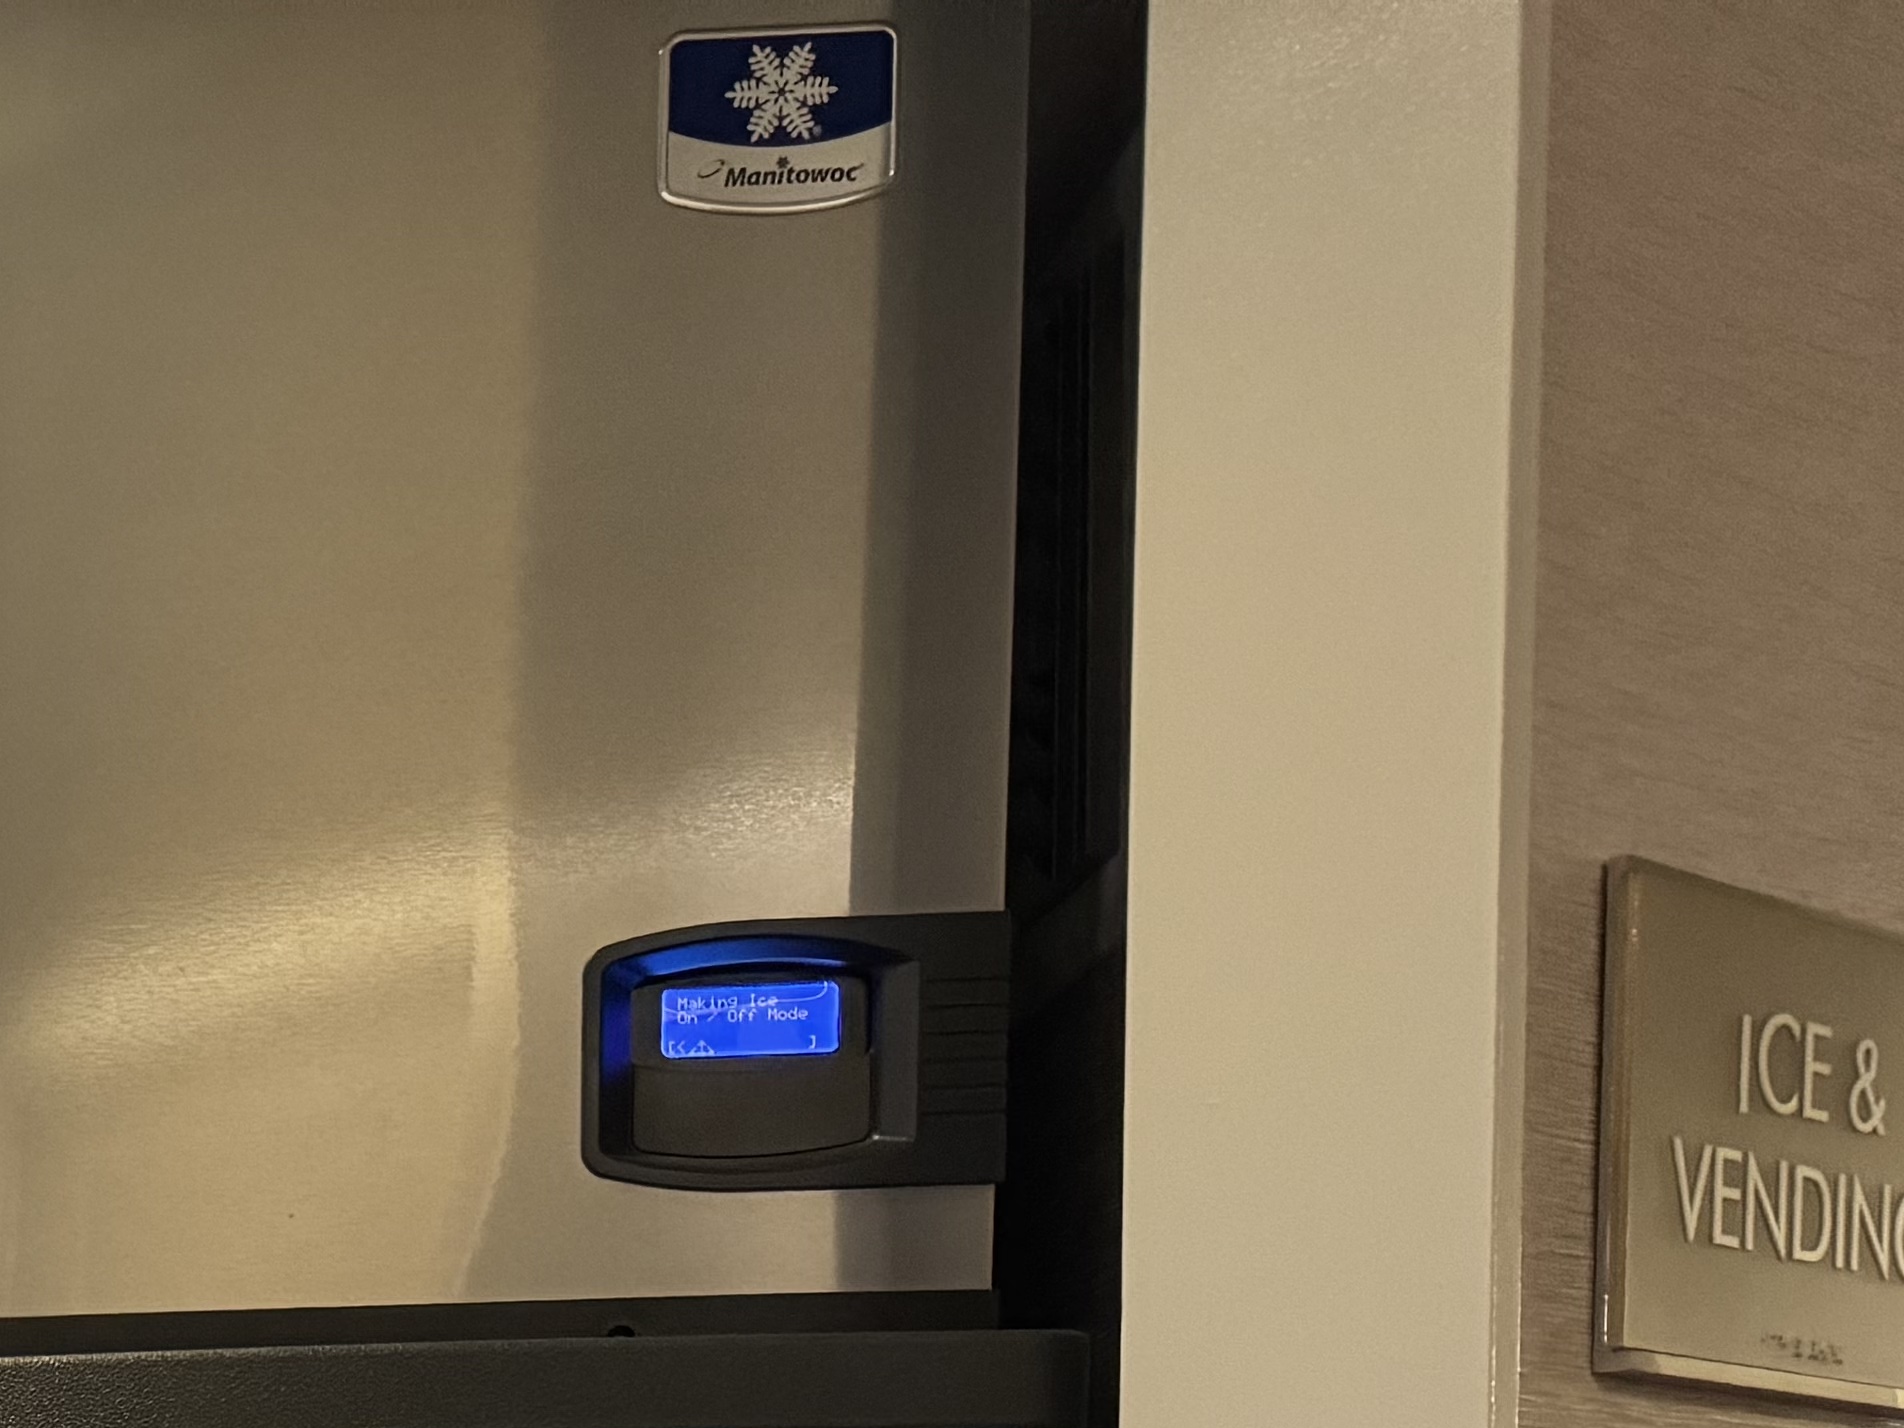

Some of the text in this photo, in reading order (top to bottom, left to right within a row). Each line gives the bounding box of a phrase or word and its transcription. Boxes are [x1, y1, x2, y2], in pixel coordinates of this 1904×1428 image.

[724, 159, 863, 188] Manitowoc
[677, 993, 778, 1010] Making Ice
[677, 1011, 698, 1025] On
[728, 1009, 758, 1022] Off
[768, 1008, 808, 1021] Mode
[1738, 1013, 1886, 1136] ICE &
[1670, 1135, 1904, 1283] VENDIN
